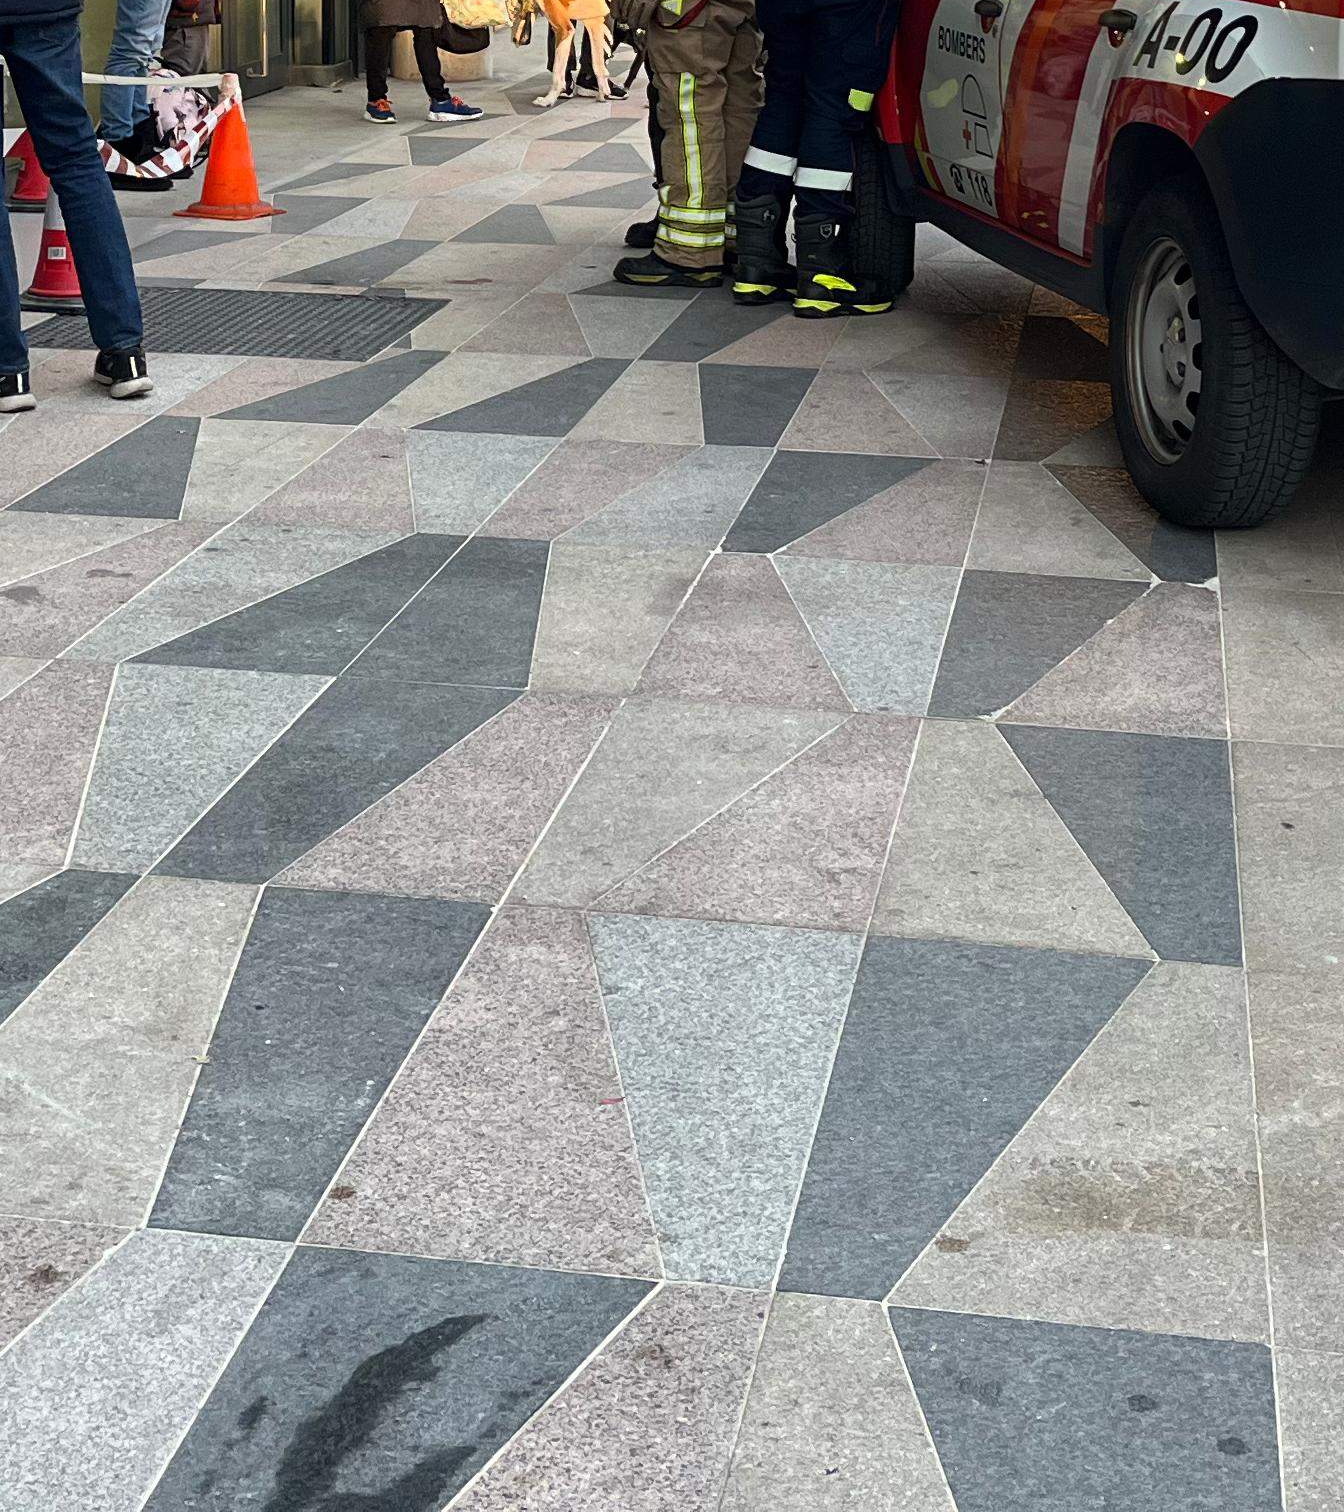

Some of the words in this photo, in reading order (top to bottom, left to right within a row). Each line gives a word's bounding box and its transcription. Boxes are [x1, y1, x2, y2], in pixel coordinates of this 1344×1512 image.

[938, 25, 986, 64] BOMBERS
[1132, 0, 1259, 84] A-00
[967, 167, 993, 207] 118
